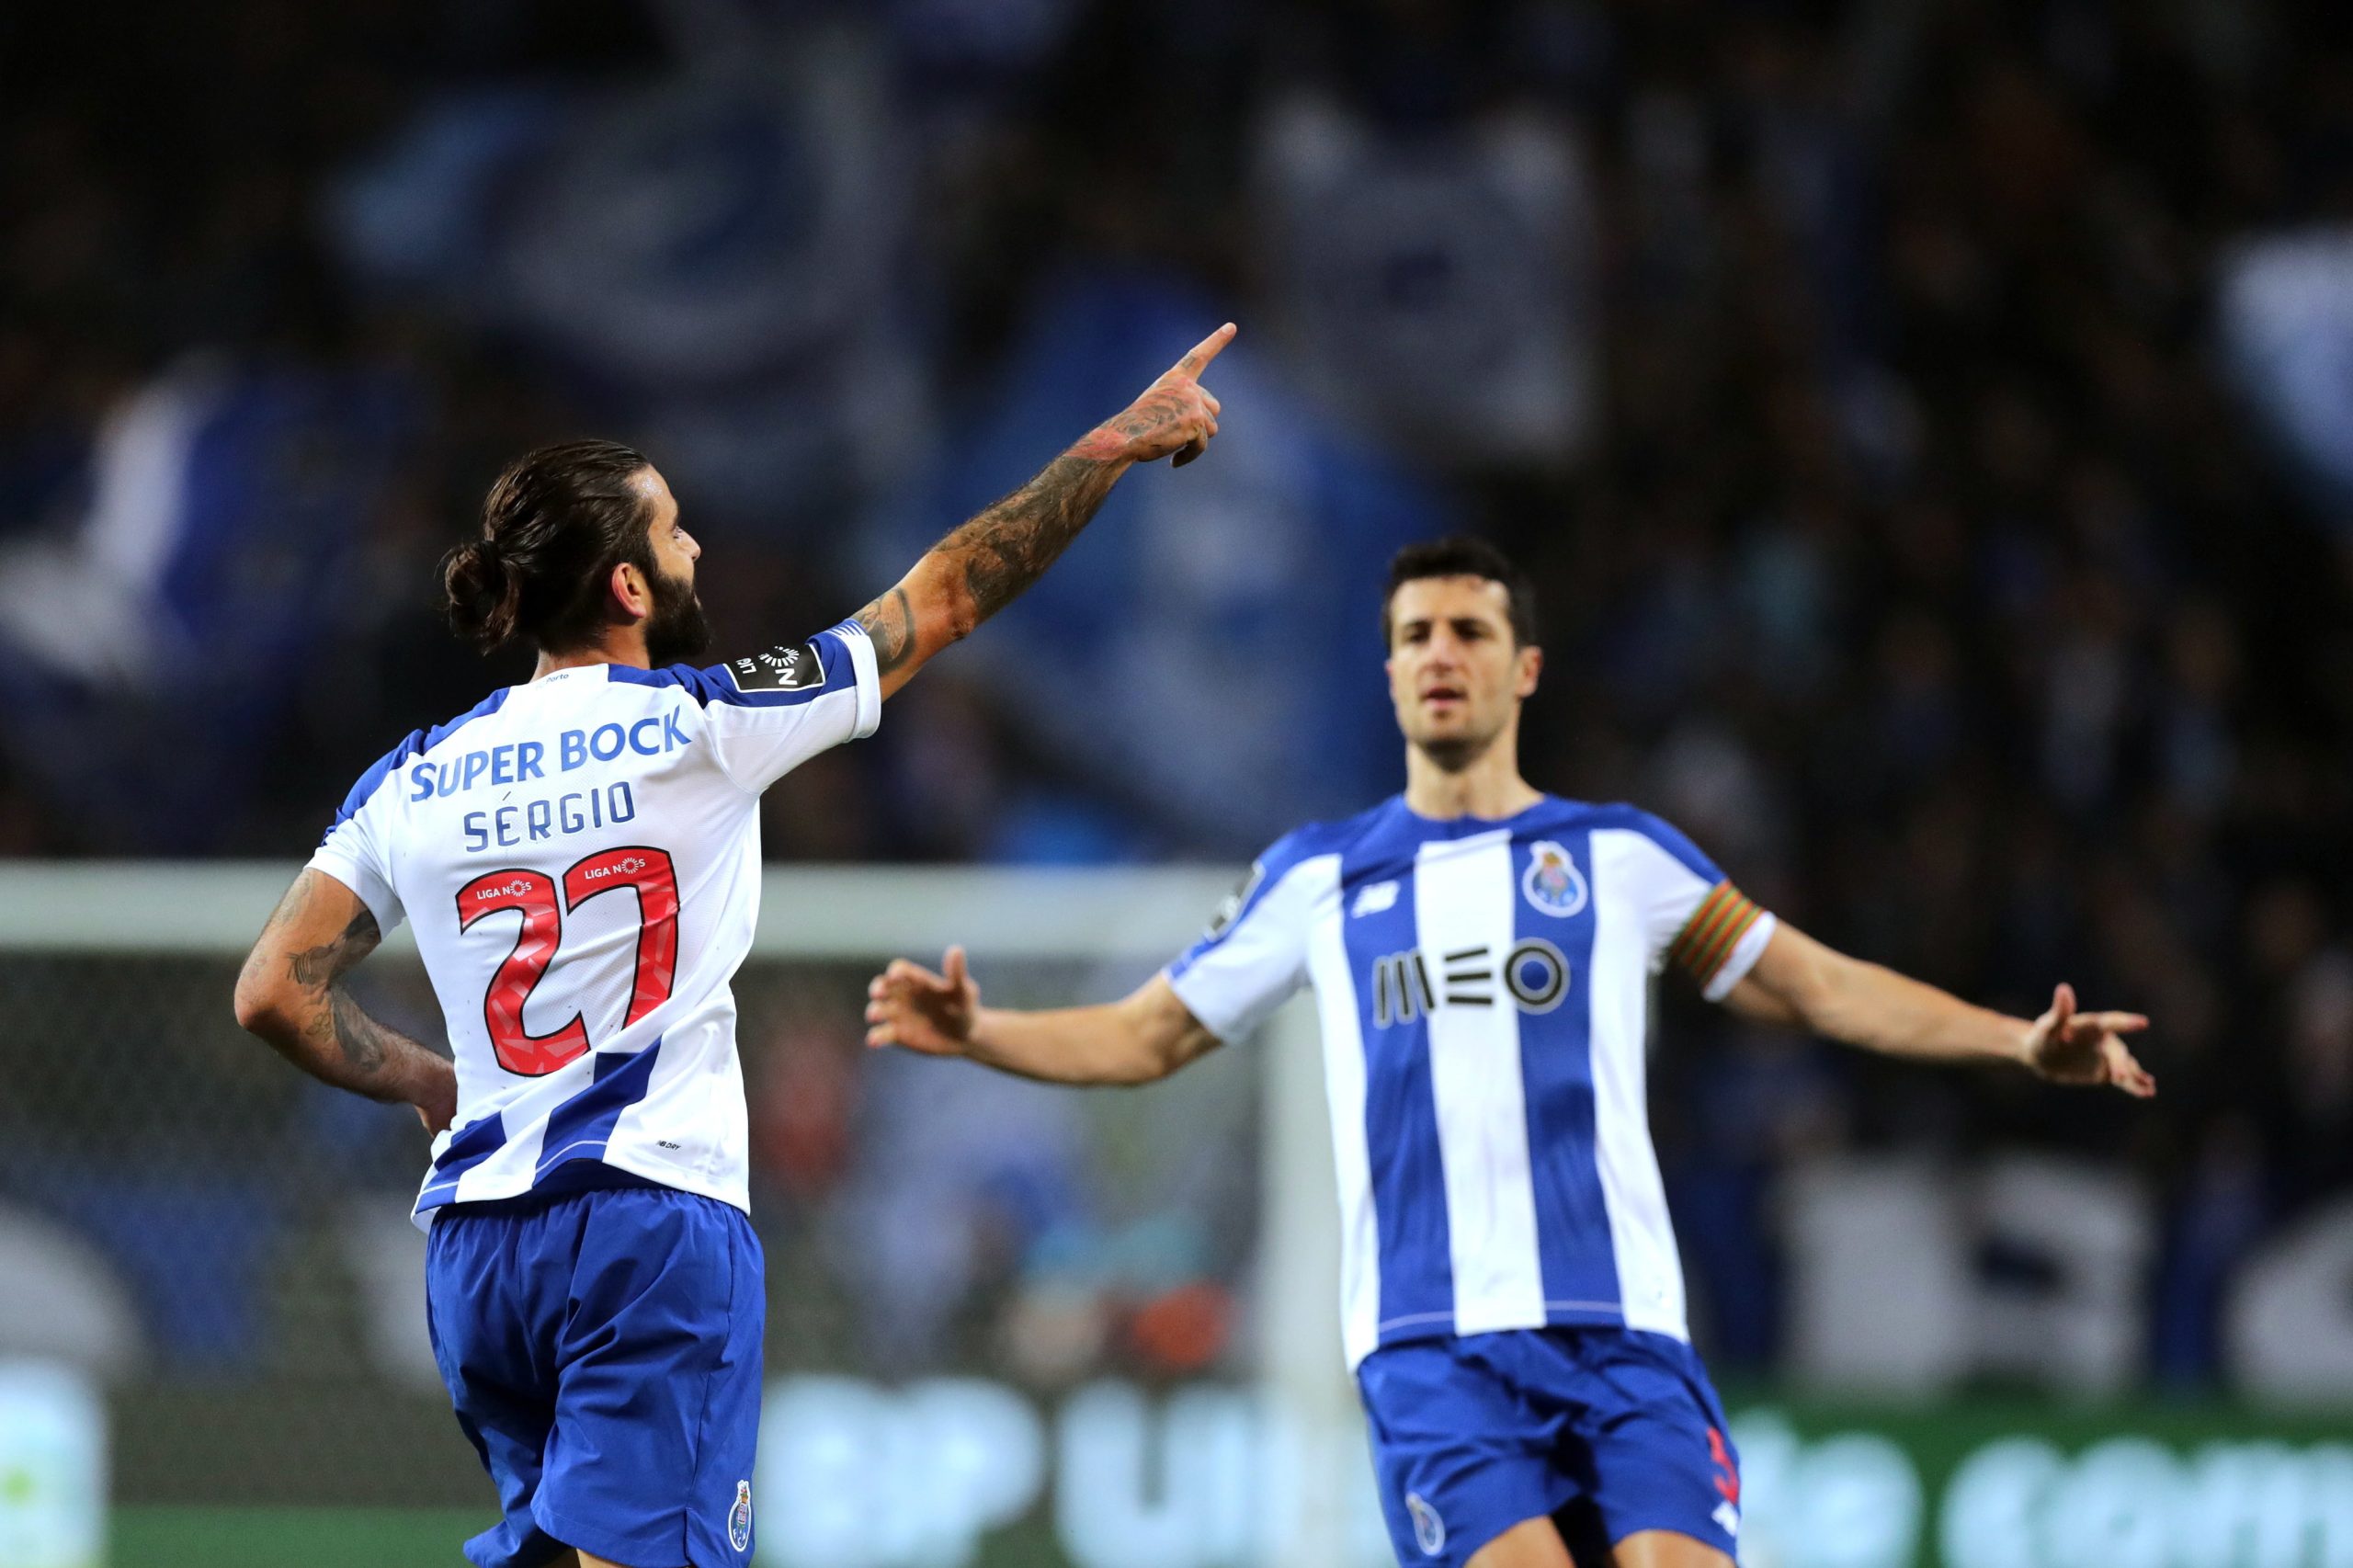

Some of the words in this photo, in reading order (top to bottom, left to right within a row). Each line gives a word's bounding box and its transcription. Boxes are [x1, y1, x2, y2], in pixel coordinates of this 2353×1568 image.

[735, 657, 757, 675] LIG
[410, 741, 547, 803] SUPER
[560, 704, 692, 772] BOCK
[462, 781, 637, 853] SÉRGIO
[476, 886, 501, 900] LIGA
[503, 880, 532, 897] NOS
[585, 866, 610, 880] LIGA
[612, 858, 646, 874] NOS
[455, 846, 681, 1078] 27
[1372, 937, 1570, 1028] MEO
